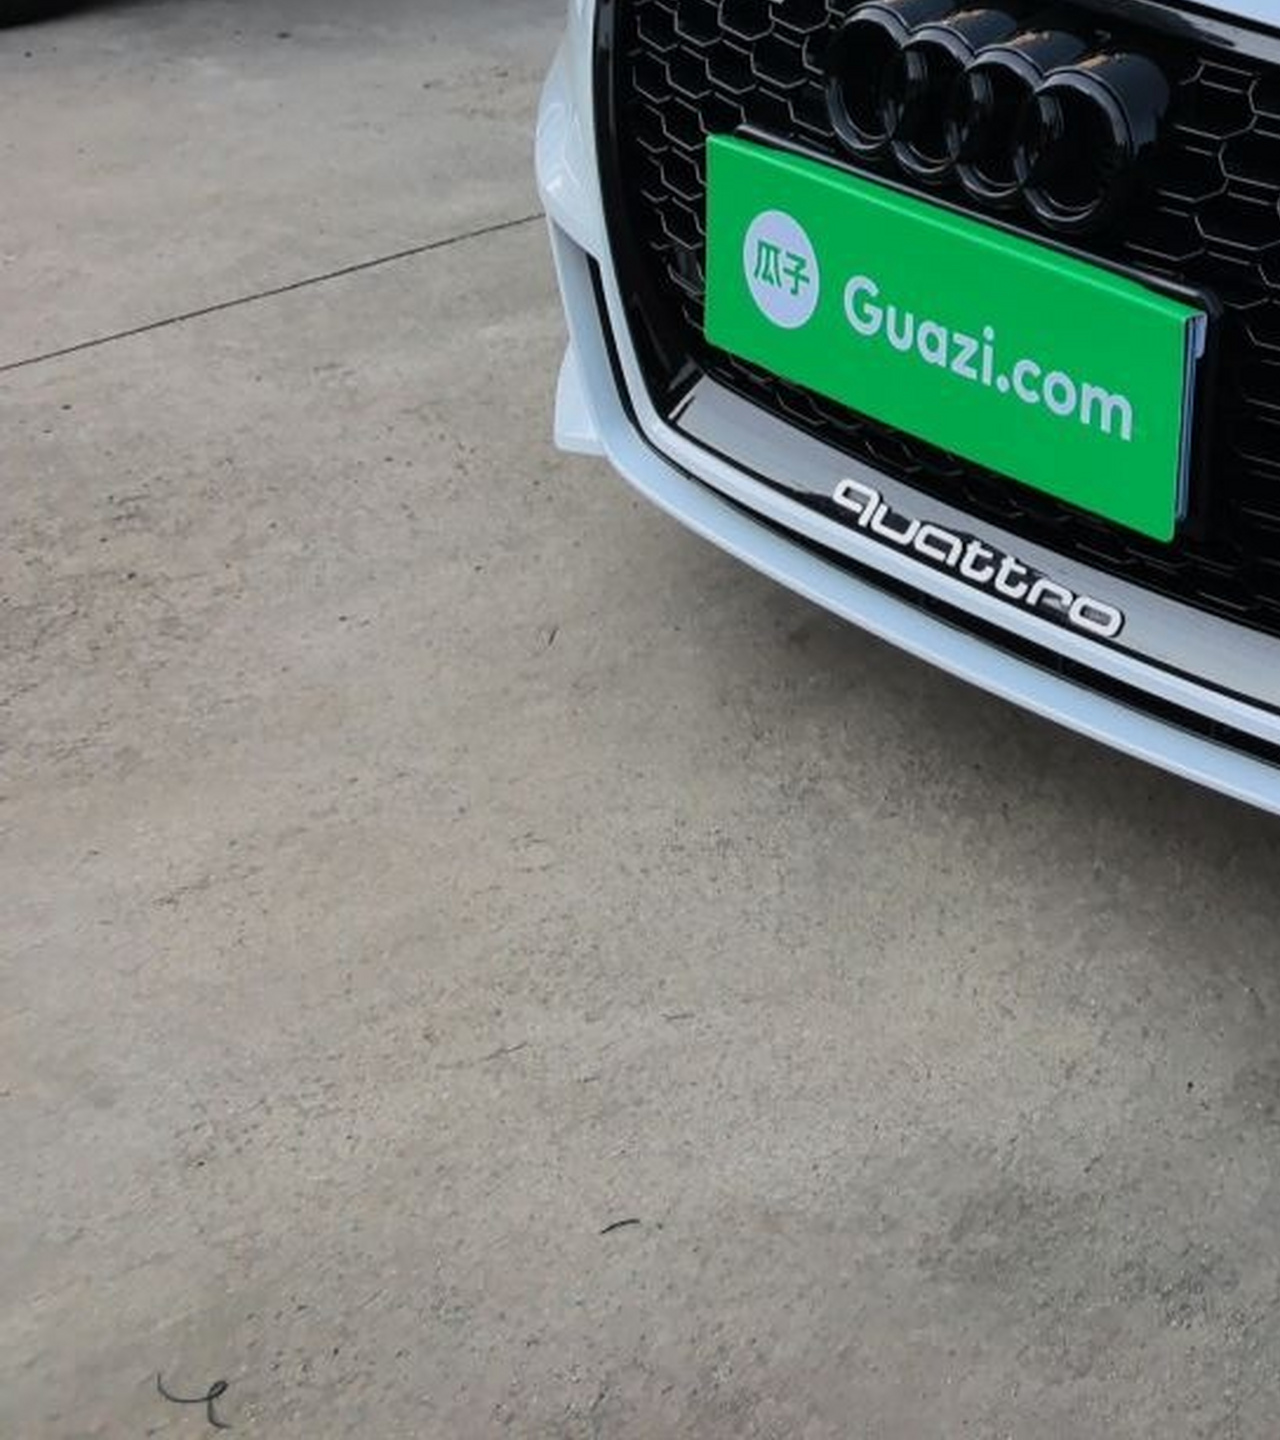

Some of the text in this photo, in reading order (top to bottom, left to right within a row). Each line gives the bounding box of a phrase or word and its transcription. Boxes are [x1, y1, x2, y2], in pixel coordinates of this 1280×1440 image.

[753, 240, 810, 295] 瓜子
[844, 275, 1133, 440] Guazi.com
[832, 479, 1124, 637] quattro
